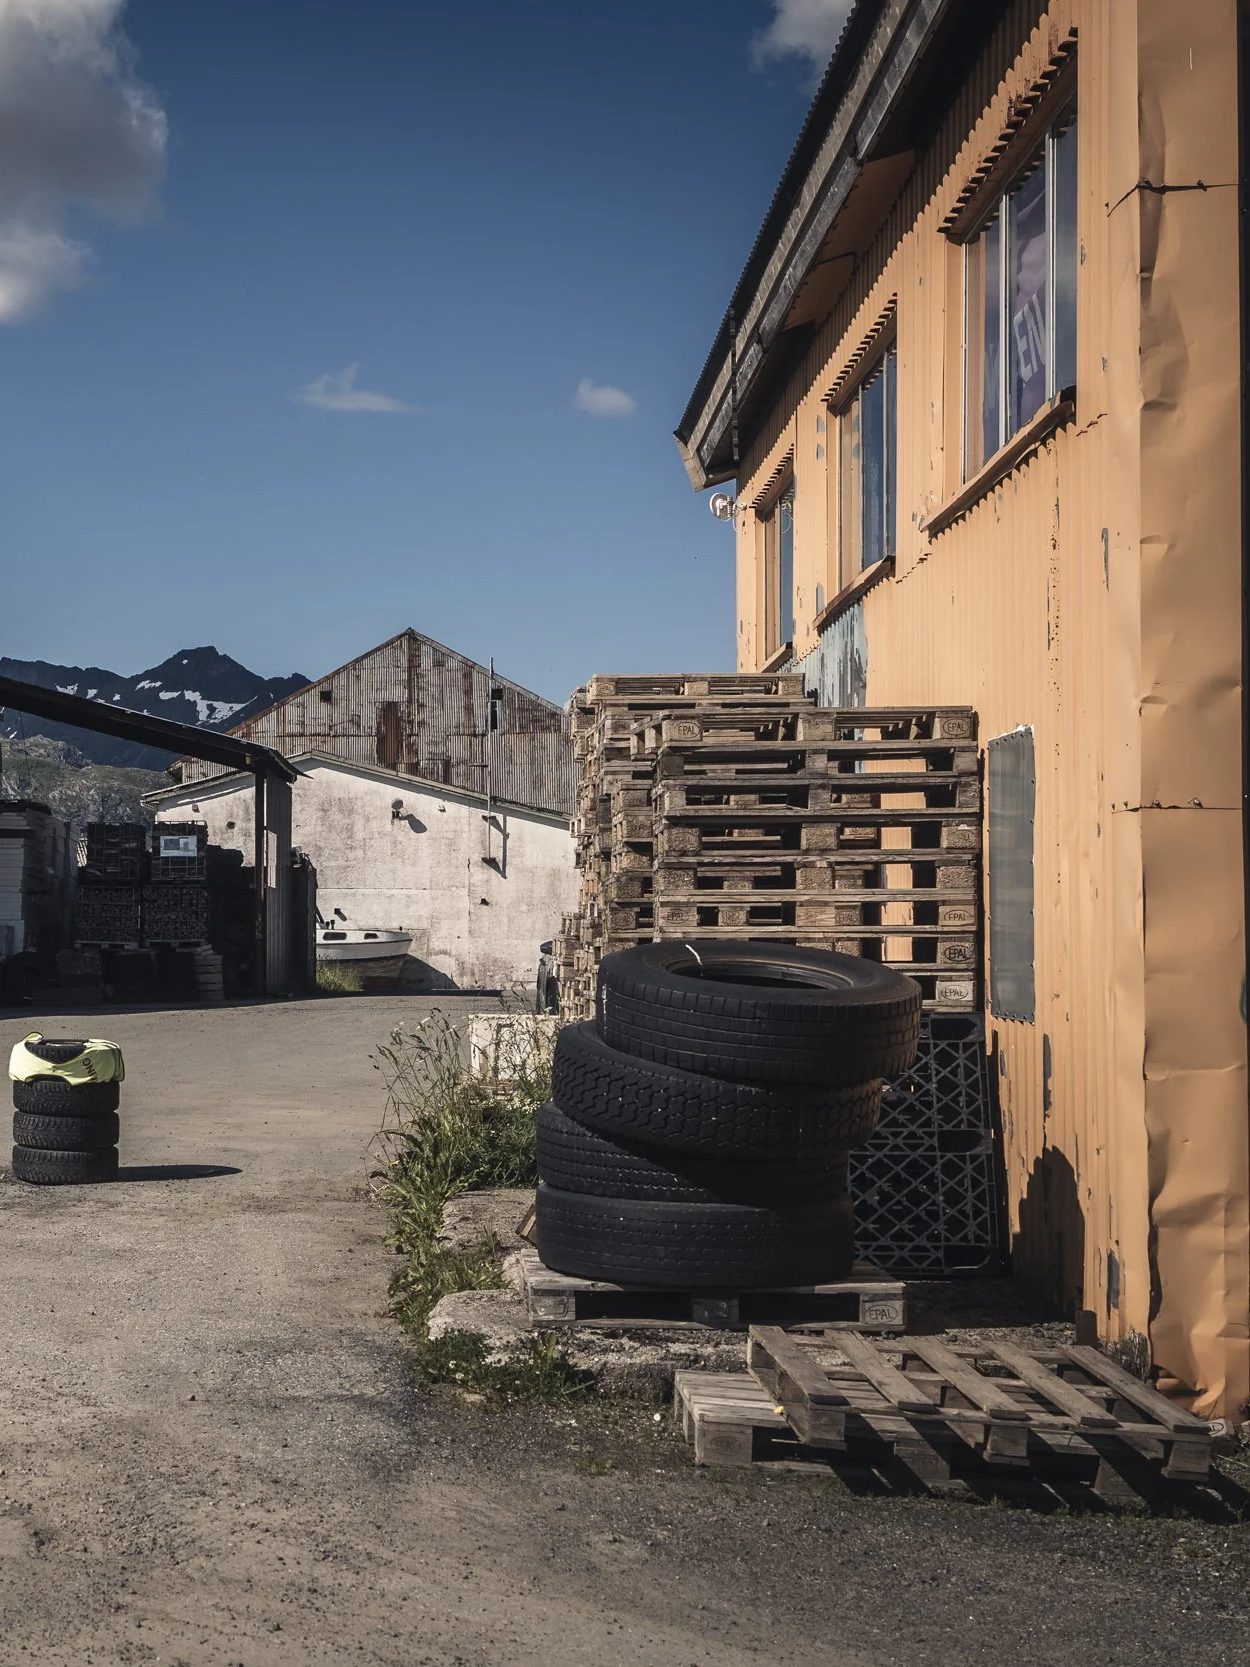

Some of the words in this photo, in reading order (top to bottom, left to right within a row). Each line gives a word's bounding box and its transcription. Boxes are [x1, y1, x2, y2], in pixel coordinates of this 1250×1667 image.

[677, 725, 696, 735] EPAL
[946, 722, 965, 732] EPAL
[948, 948, 967, 959] EPAL
[944, 988, 964, 997] EPAL
[869, 1308, 894, 1320] EPAL
